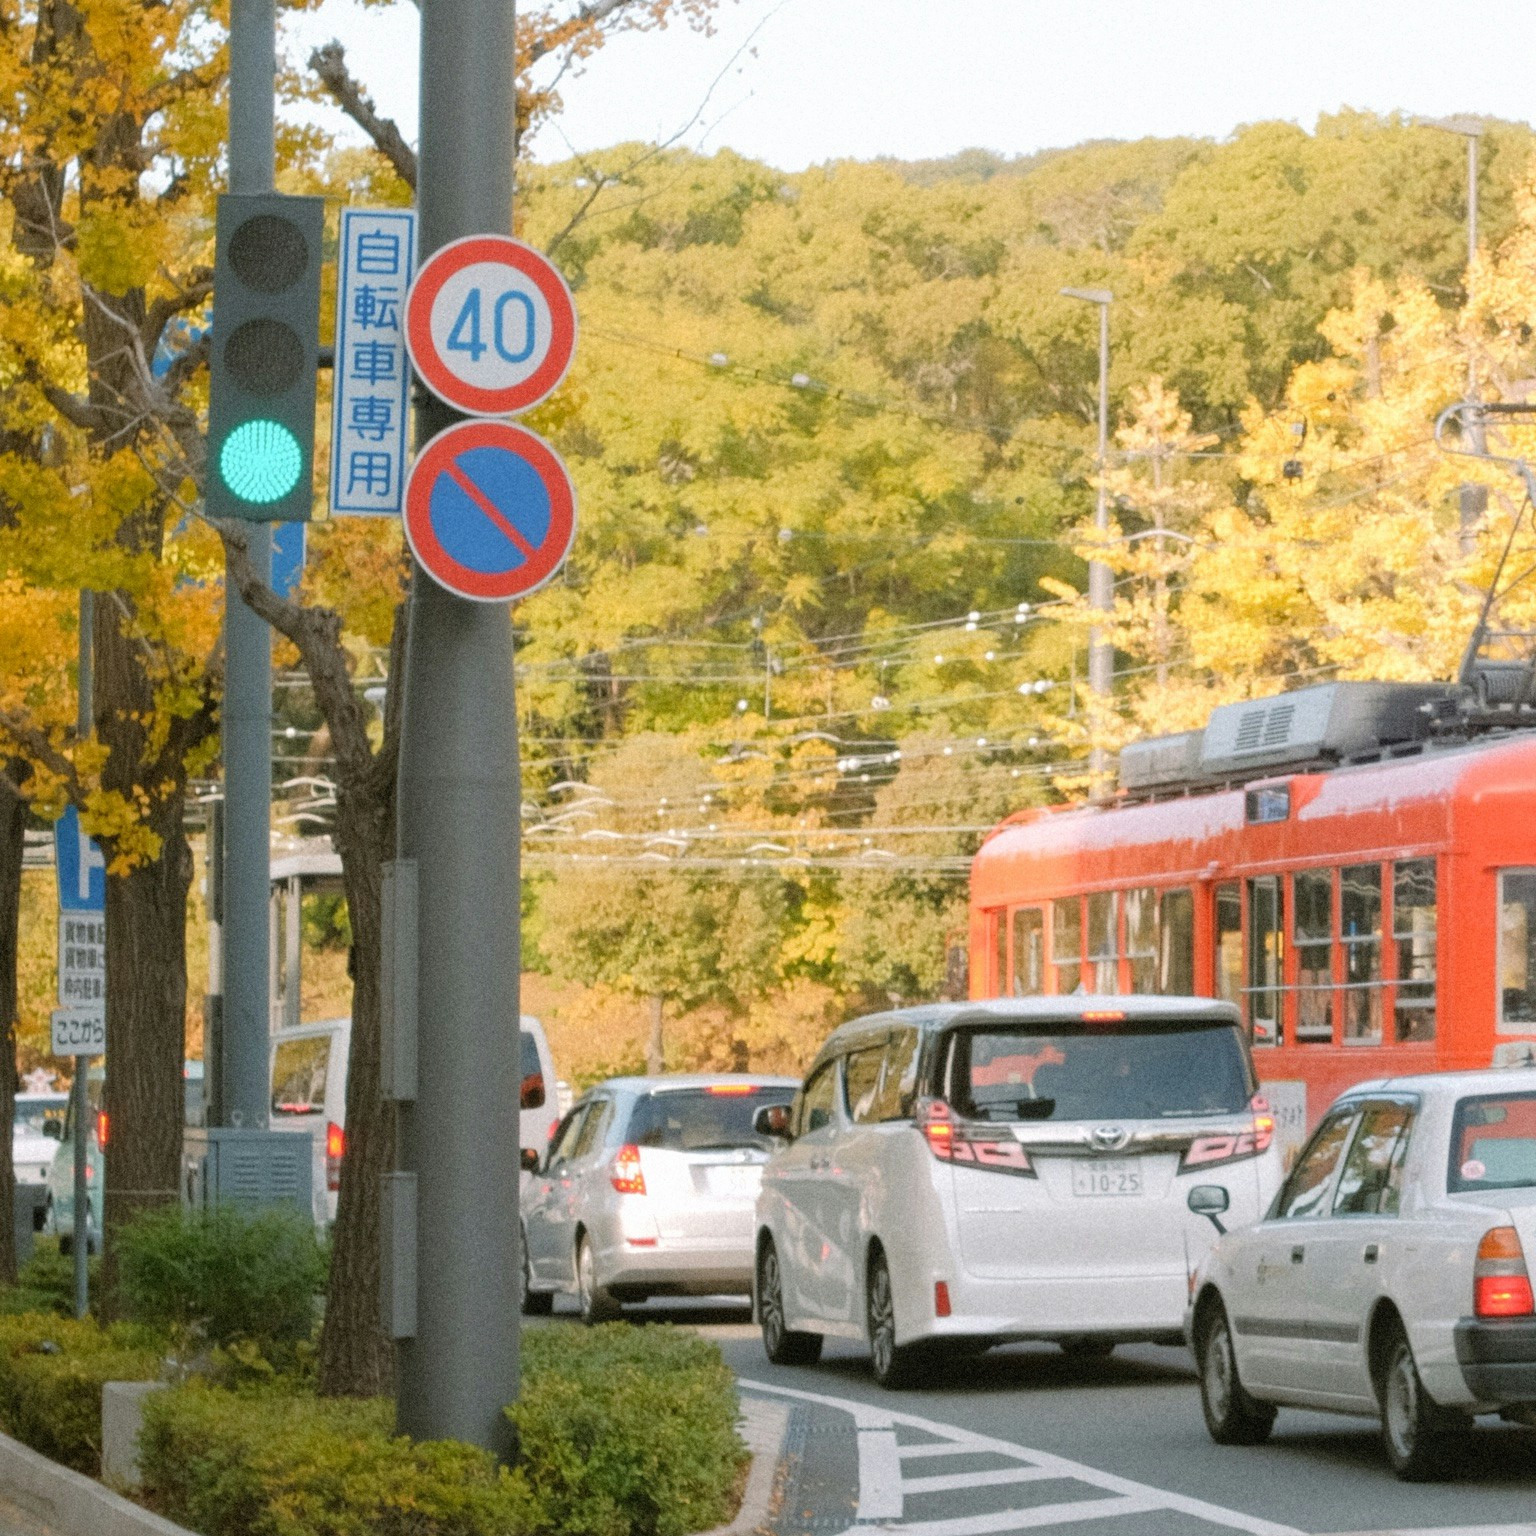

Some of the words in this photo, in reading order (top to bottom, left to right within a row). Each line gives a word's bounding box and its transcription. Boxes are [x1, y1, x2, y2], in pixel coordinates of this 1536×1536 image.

[346, 229, 399, 498] 自転車専用
[446, 287, 536, 364] 40
[56, 1017, 105, 1046] ここから
